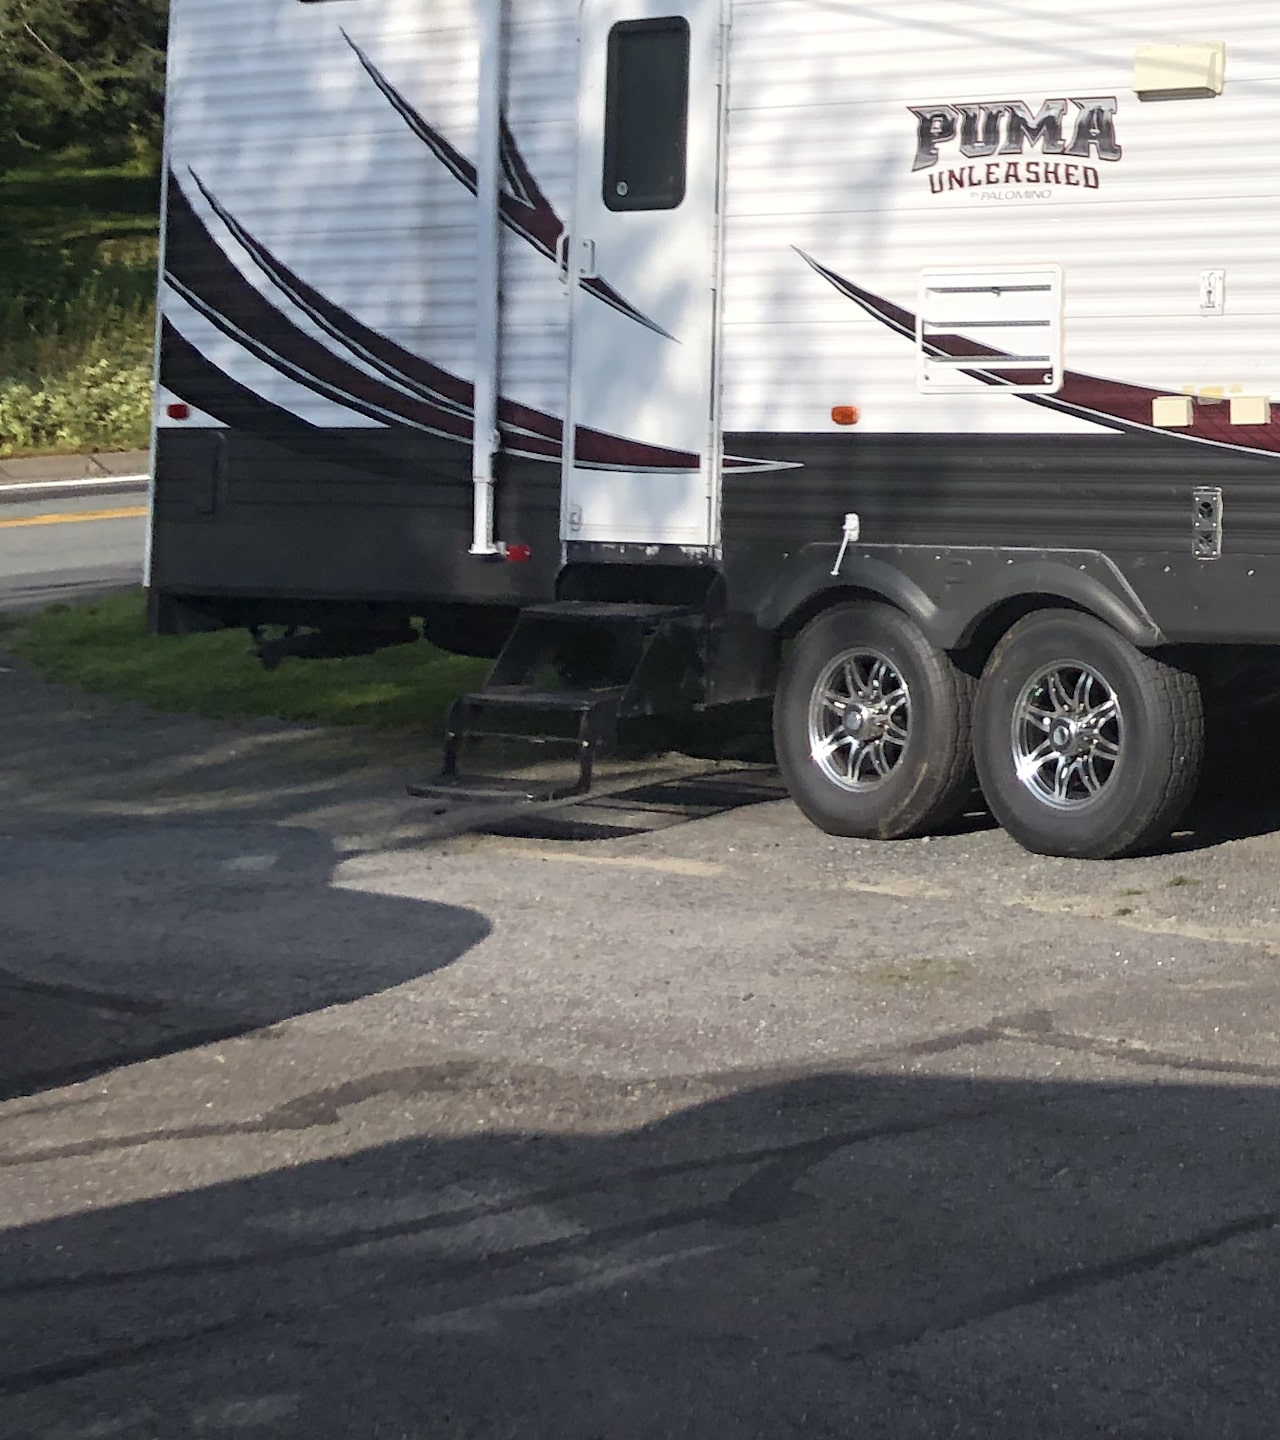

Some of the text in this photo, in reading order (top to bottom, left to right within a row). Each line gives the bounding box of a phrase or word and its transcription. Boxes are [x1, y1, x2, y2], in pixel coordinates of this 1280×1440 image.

[906, 96, 1123, 173] PUMA
[928, 161, 1100, 194] UNLEASHED
[980, 189, 1053, 201] PALOMINO
